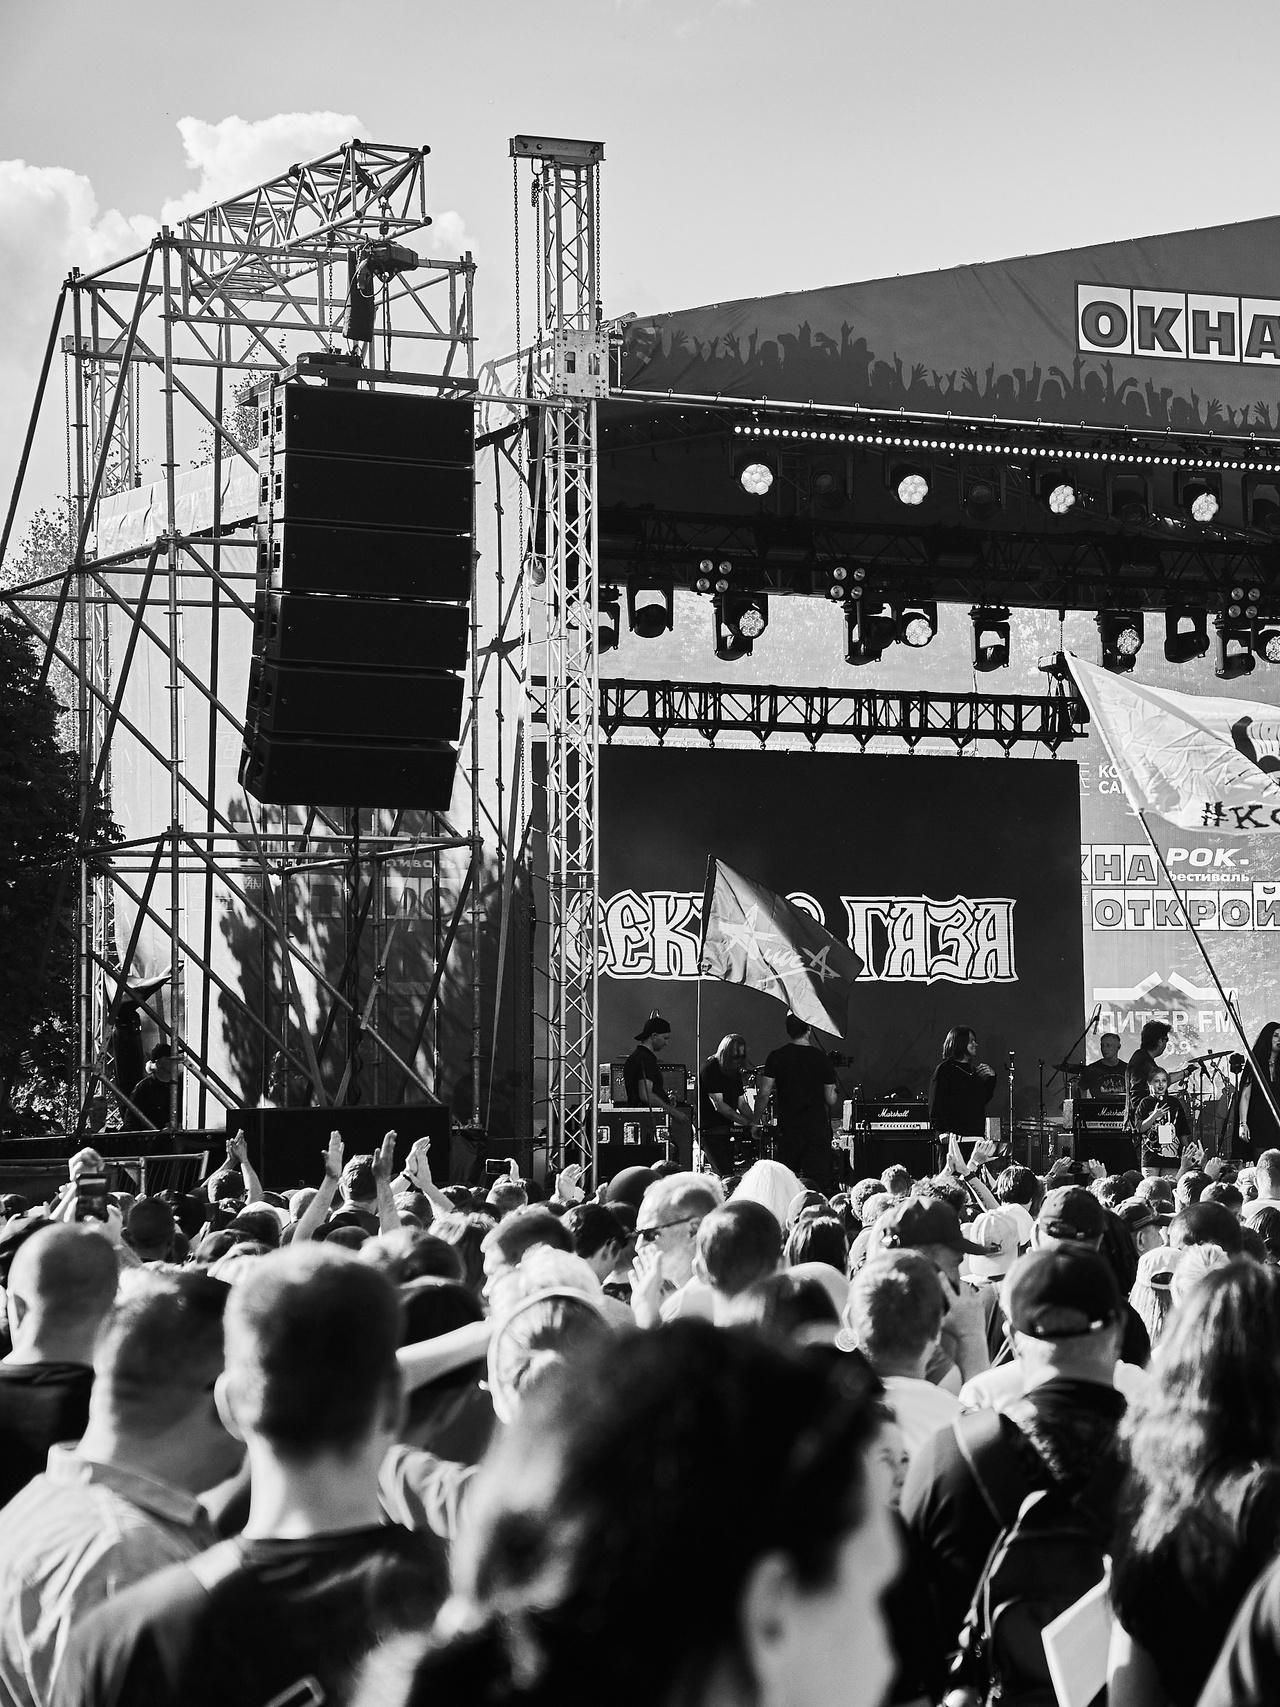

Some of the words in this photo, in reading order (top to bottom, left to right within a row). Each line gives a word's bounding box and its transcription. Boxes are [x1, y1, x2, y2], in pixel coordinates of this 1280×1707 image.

[840, 893, 1020, 984] ГАЗА
[1198, 1010, 1236, 1033] FM
[877, 1107, 910, 1118] Marshall
